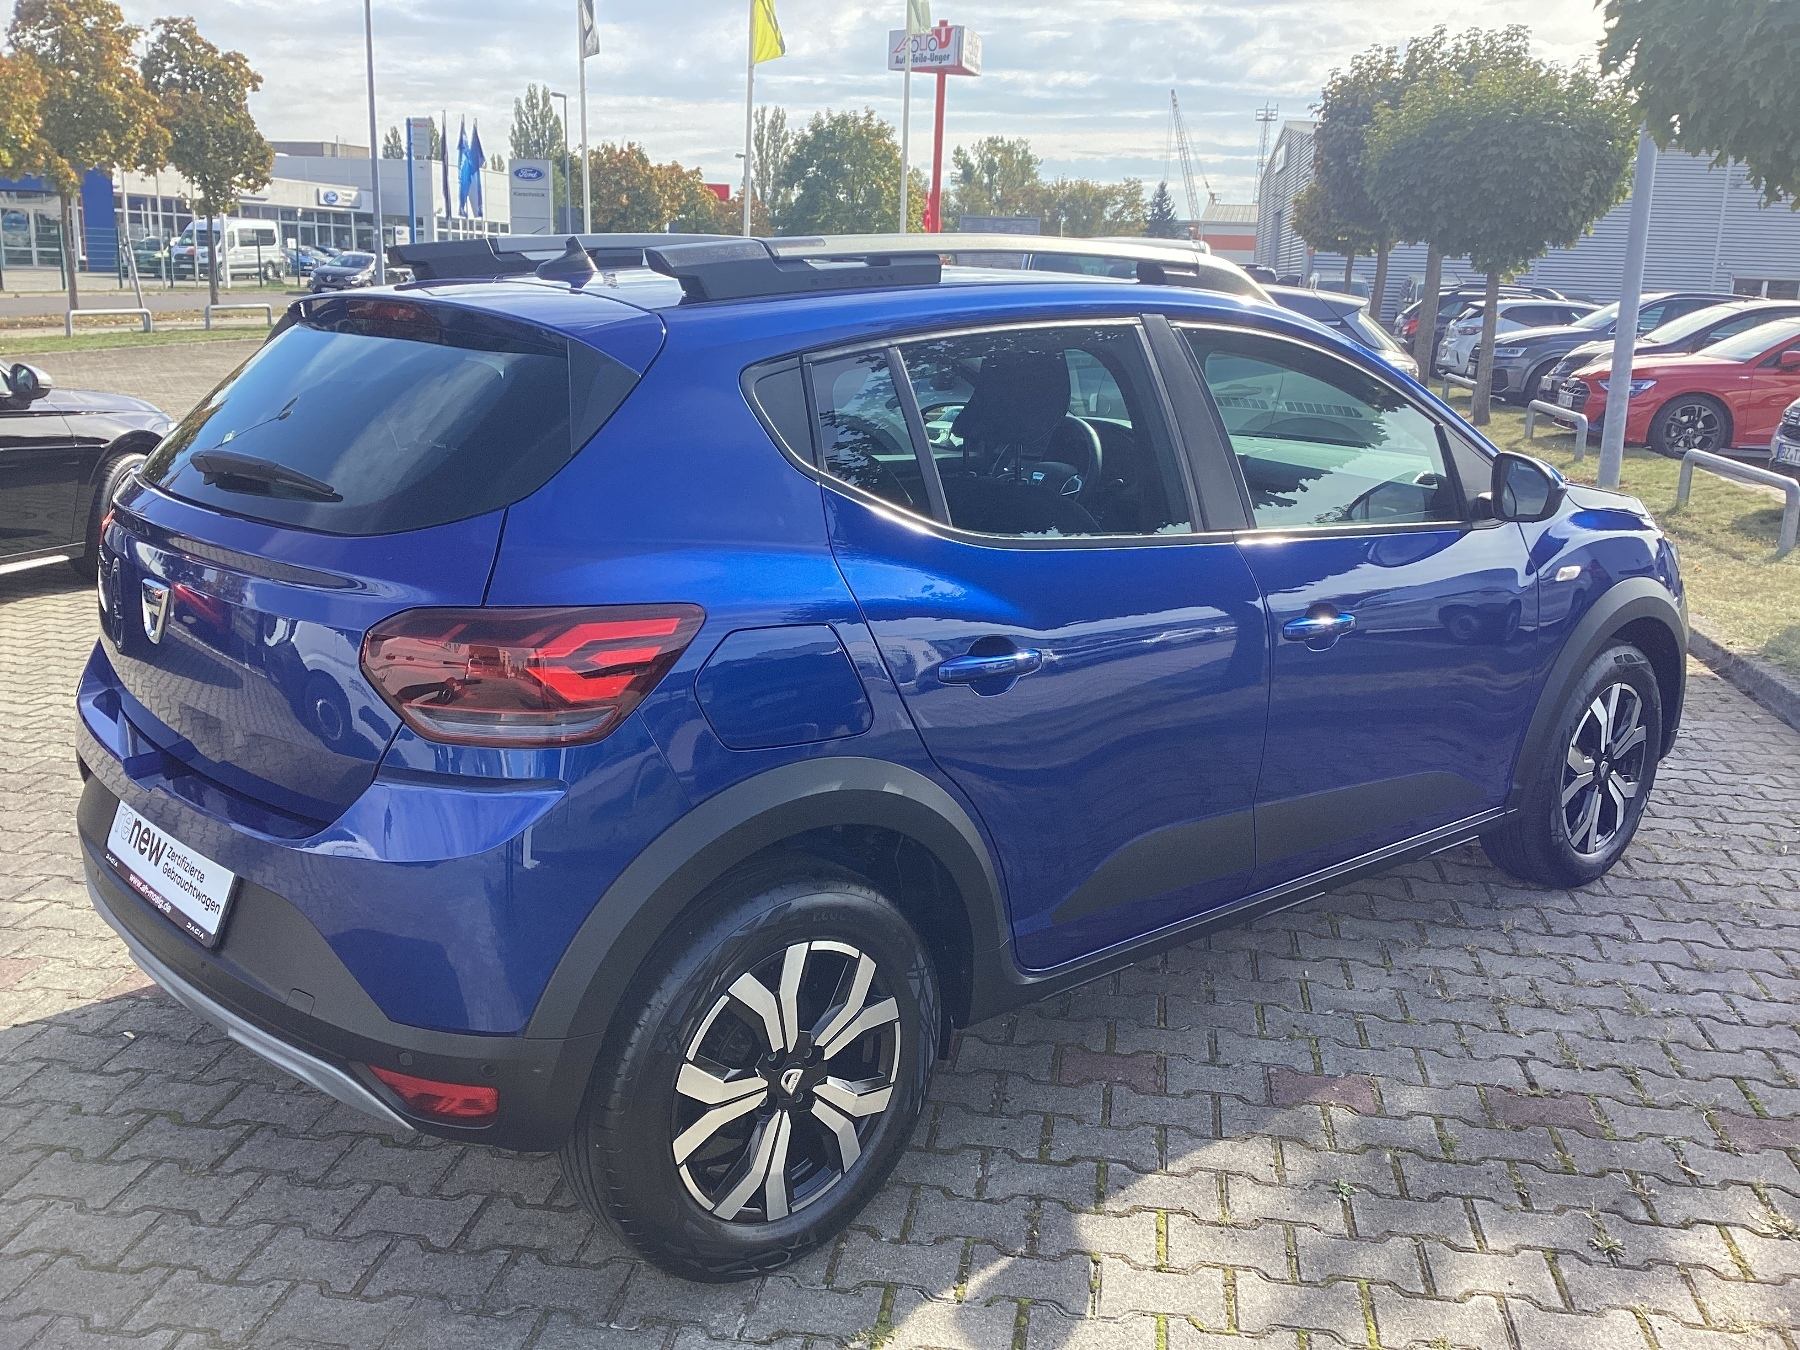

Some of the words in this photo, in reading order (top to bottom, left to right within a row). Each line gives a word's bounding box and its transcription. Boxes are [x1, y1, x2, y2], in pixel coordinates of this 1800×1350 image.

[895, 52, 950, 65] Aut-Teile-Unger
[518, 167, 538, 178] Ford
[166, 846, 205, 884] Zertifizierte
[105, 853, 118, 868] DACIA
[186, 921, 204, 940] DACIA
[162, 862, 221, 915] Gebrauchtwagen
